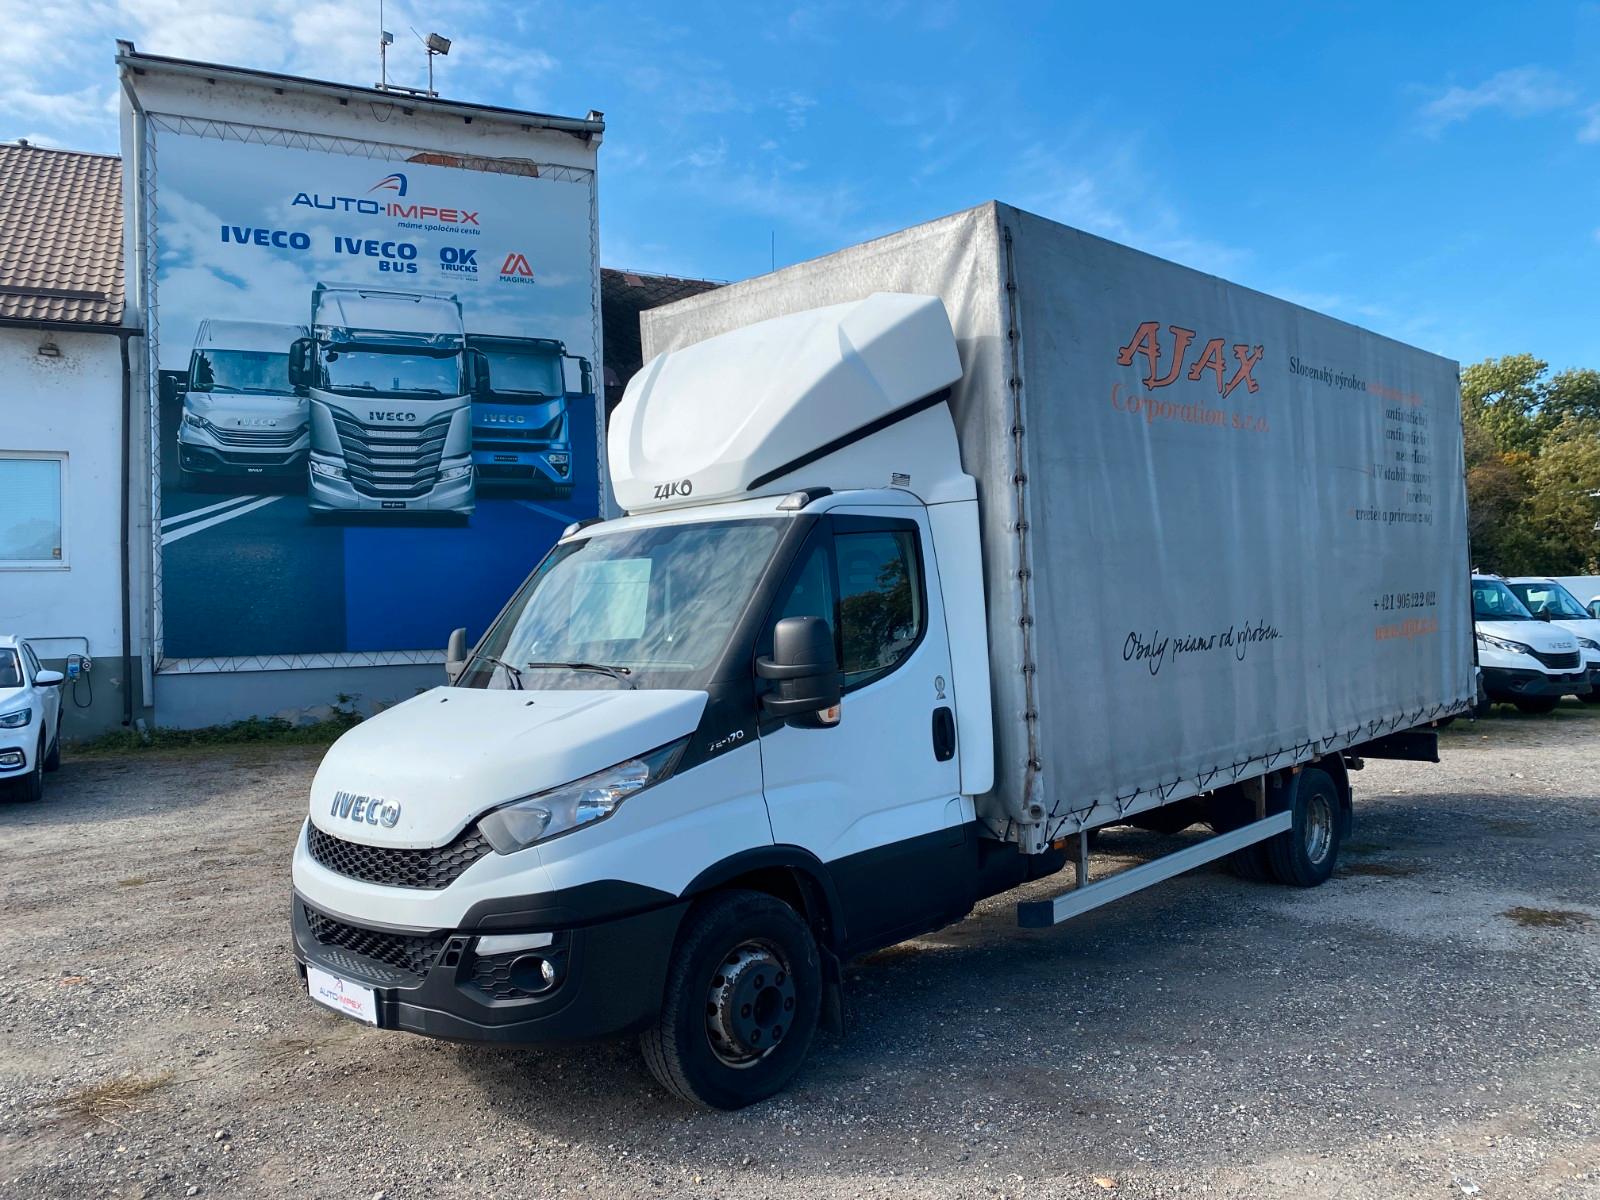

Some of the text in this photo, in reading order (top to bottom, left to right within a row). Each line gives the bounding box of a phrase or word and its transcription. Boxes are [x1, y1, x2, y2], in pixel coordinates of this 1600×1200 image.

[291, 191, 480, 226] AUTO-IMPEX
[221, 225, 311, 250] IVECO
[461, 228, 481, 236] cestu
[334, 236, 418, 260] IVECO
[439, 246, 478, 266] OK
[378, 260, 418, 274] BUS
[440, 263, 478, 273] TRUCKS
[499, 275, 535, 285] MAGIRUS
[1117, 321, 1264, 399] AJAX
[1289, 356, 1366, 392] Slovenský výrobca
[1111, 383, 1227, 427] Corporation
[237, 417, 278, 427] IVECO
[369, 411, 417, 422] IVECO
[484, 414, 526, 424] IVECO
[654, 479, 693, 500] ZAKO
[1123, 629, 1169, 676] Obaly
[1173, 634, 1217, 663] priamo
[1219, 625, 1234, 648] od
[330, 791, 402, 829] IVECO
